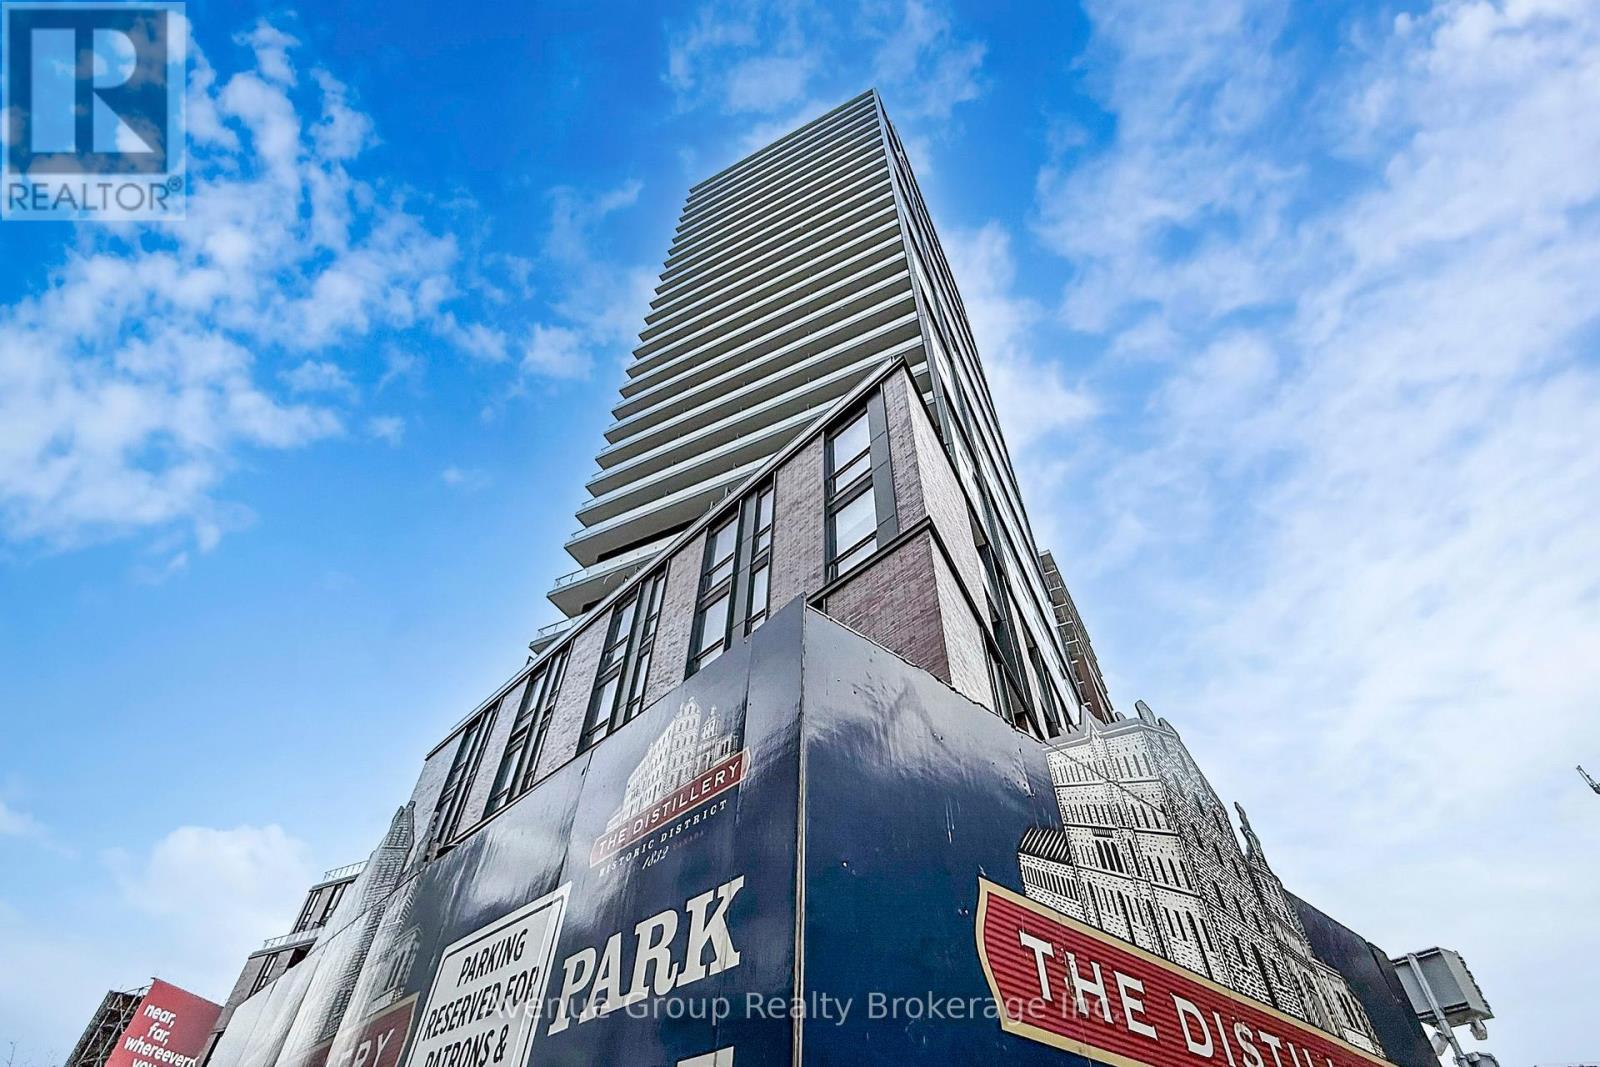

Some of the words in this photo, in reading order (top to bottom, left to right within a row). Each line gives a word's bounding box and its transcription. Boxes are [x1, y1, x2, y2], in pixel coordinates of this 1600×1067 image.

[599, 825, 627, 855] THE
[633, 760, 740, 834] DISTILLERY
[660, 799, 728, 843] DISTRICT
[642, 845, 670, 870] 1832
[456, 928, 529, 988] PARKING
[547, 874, 745, 1037] PARK
[1018, 930, 1159, 1041] THE
[143, 1004, 177, 1028] near,
[422, 981, 502, 1042] RESERVED
[501, 965, 540, 1012] FOR
[1169, 991, 1333, 1067] DIST
[147, 1022, 170, 1047] far,
[424, 1029, 495, 1067] PATRONS
[493, 1024, 509, 1063] &
